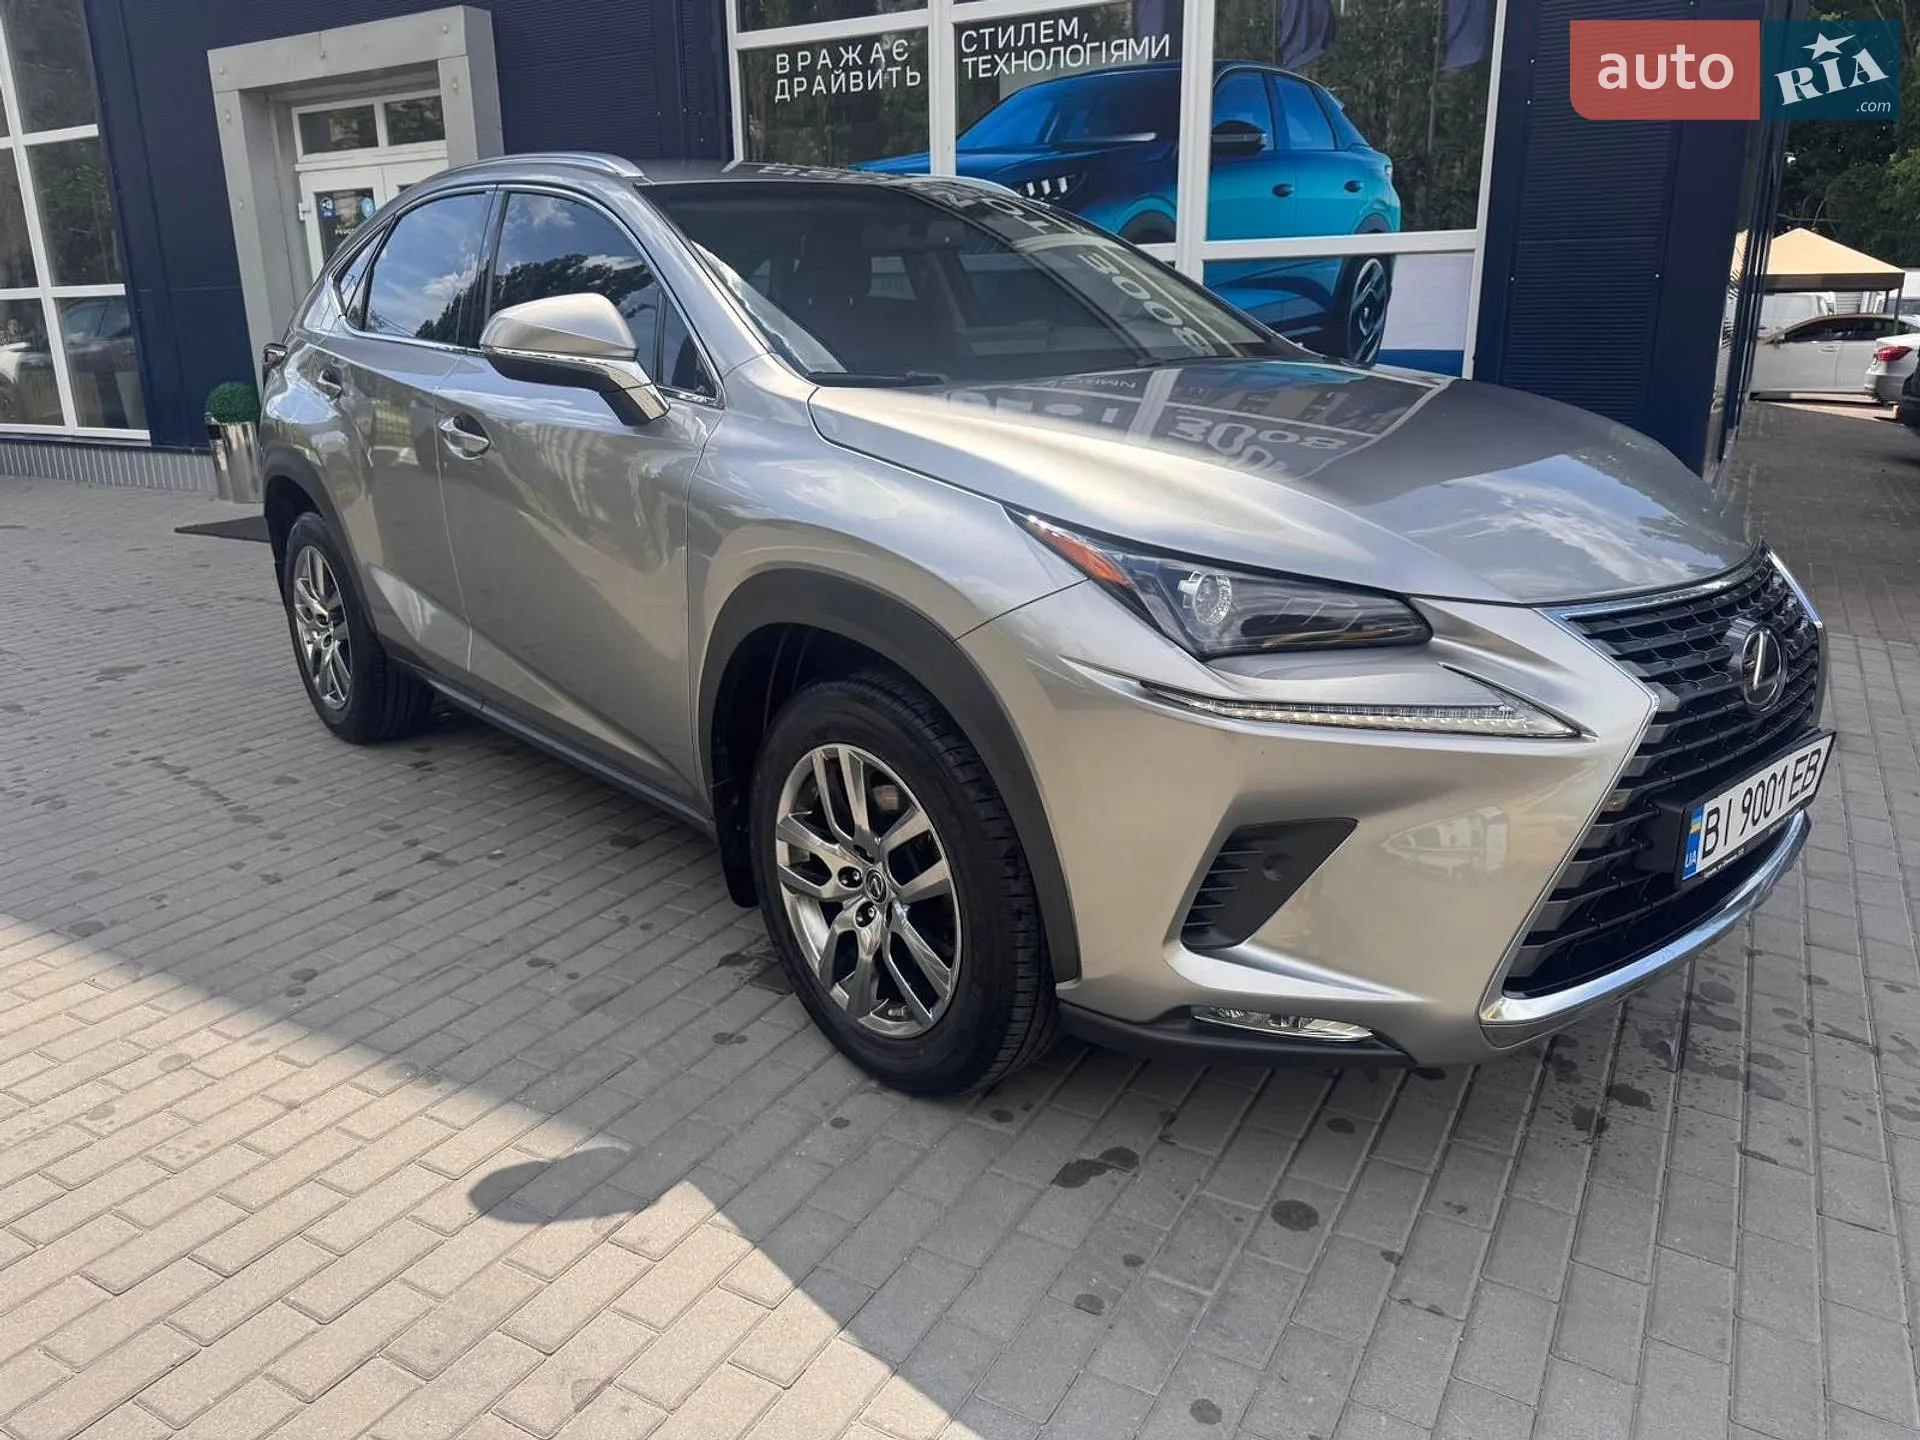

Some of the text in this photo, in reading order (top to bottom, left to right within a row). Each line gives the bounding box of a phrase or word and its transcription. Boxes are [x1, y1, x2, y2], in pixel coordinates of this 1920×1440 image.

[961, 16, 1089, 53] СТИЛЕМ,
[776, 39, 909, 74] ВРАЖАЄ
[962, 33, 1170, 80] ТЕХНОЛОГІЯМИ
[775, 65, 921, 103] ДРАЙВИТЬ
[1702, 798, 1733, 861] BI
[1739, 764, 1788, 837] 9001
[1788, 747, 1822, 802] EB
[1684, 849, 1698, 869] UA
